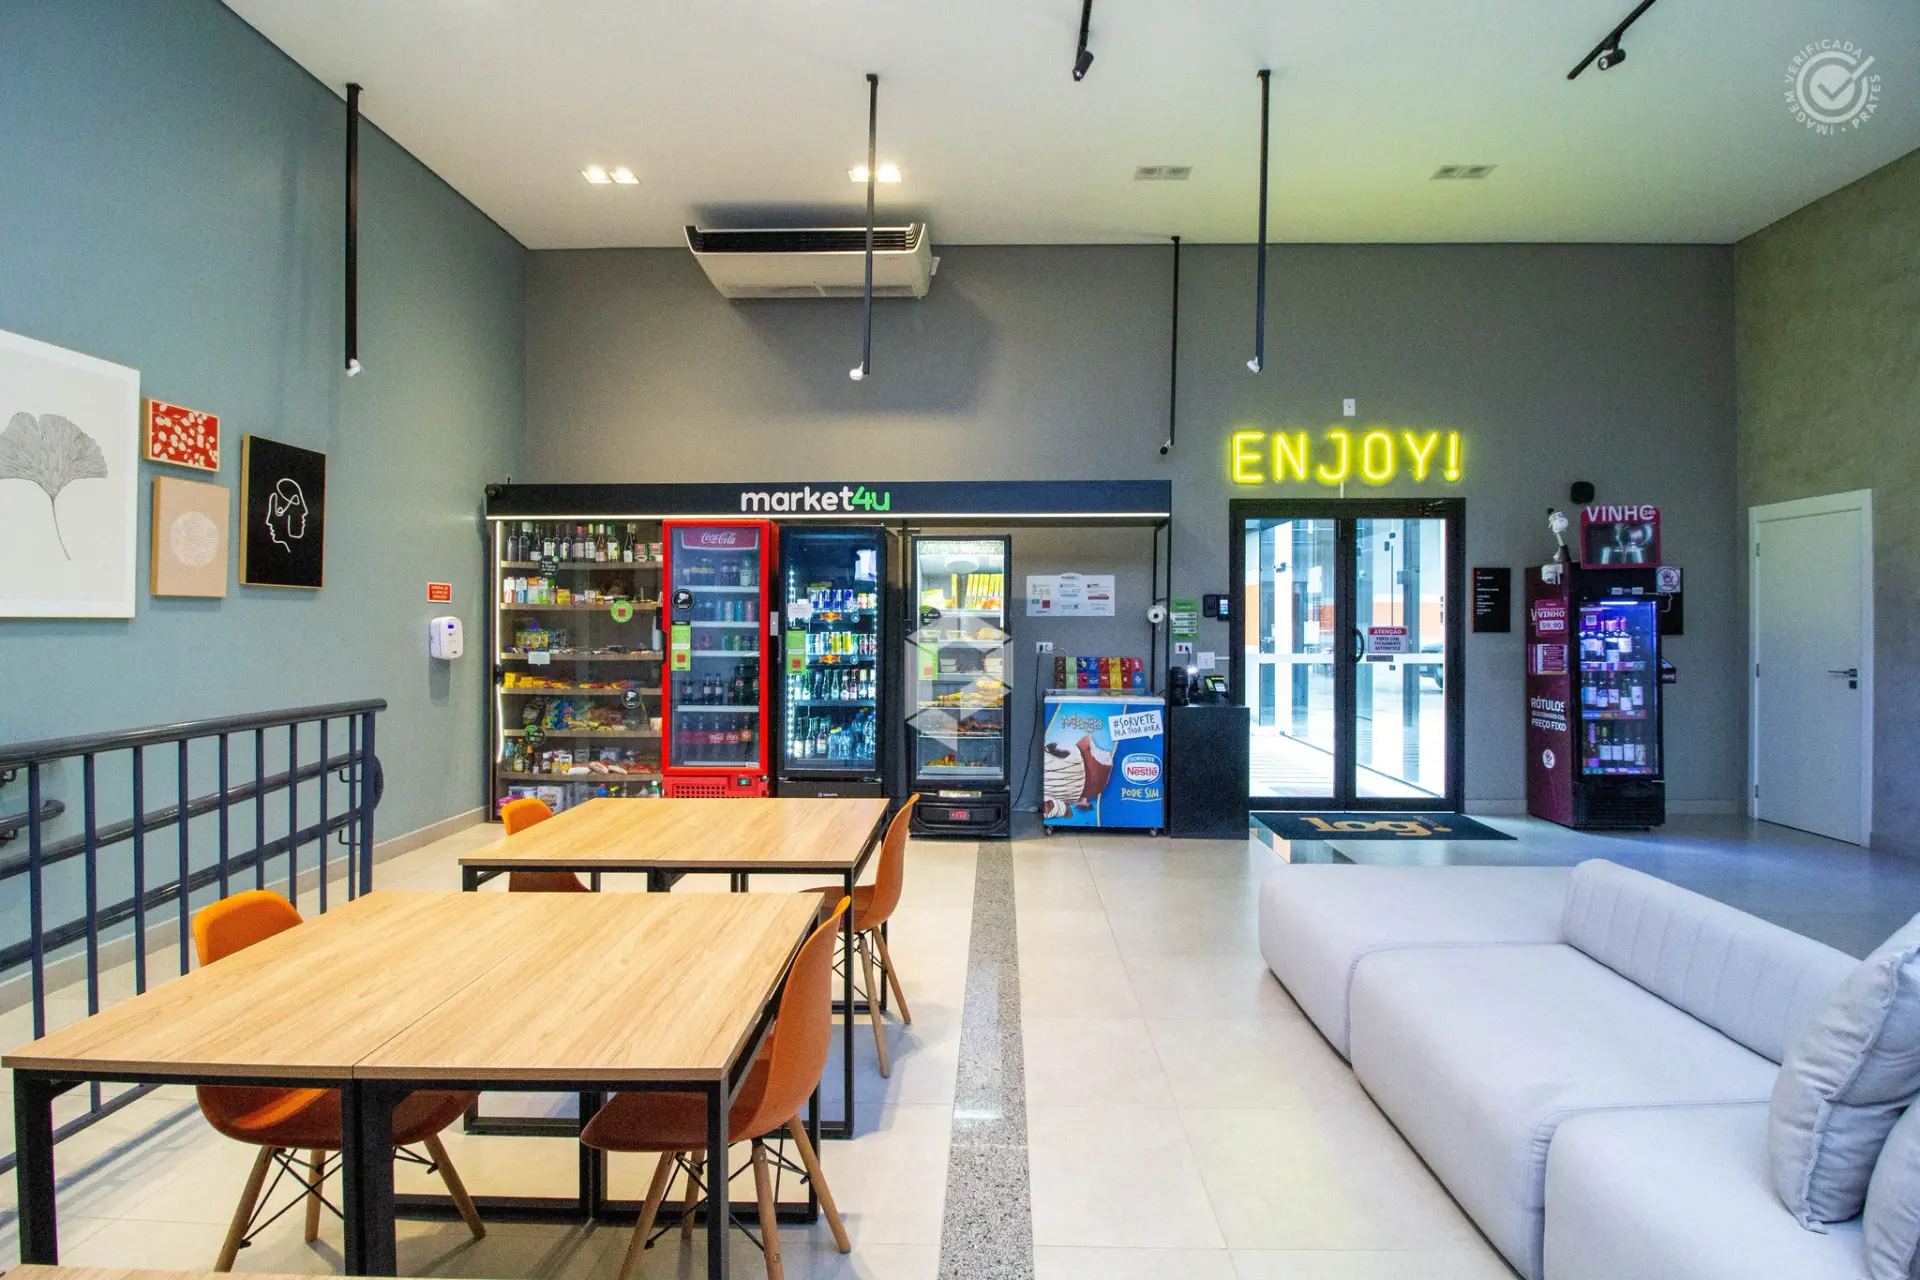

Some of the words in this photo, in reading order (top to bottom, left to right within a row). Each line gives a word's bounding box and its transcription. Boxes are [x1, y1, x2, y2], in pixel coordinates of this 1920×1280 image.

[1233, 430, 1459, 484] ENJOY!
[741, 486, 890, 511] market4u
[1586, 504, 1655, 522] VINHO
[1538, 610, 1565, 618] VINHO
[1531, 696, 1565, 712] RÓTULOS
[1062, 714, 1102, 733] Mega
[1113, 714, 1155, 728] #SORVETE
[1531, 718, 1550, 730] PREÇO
[1551, 721, 1567, 732] FIXO
[1114, 729, 1126, 737] PRA
[1127, 727, 1142, 735] TODA
[1121, 787, 1142, 798] PODE
[1144, 787, 1159, 798] SIM
